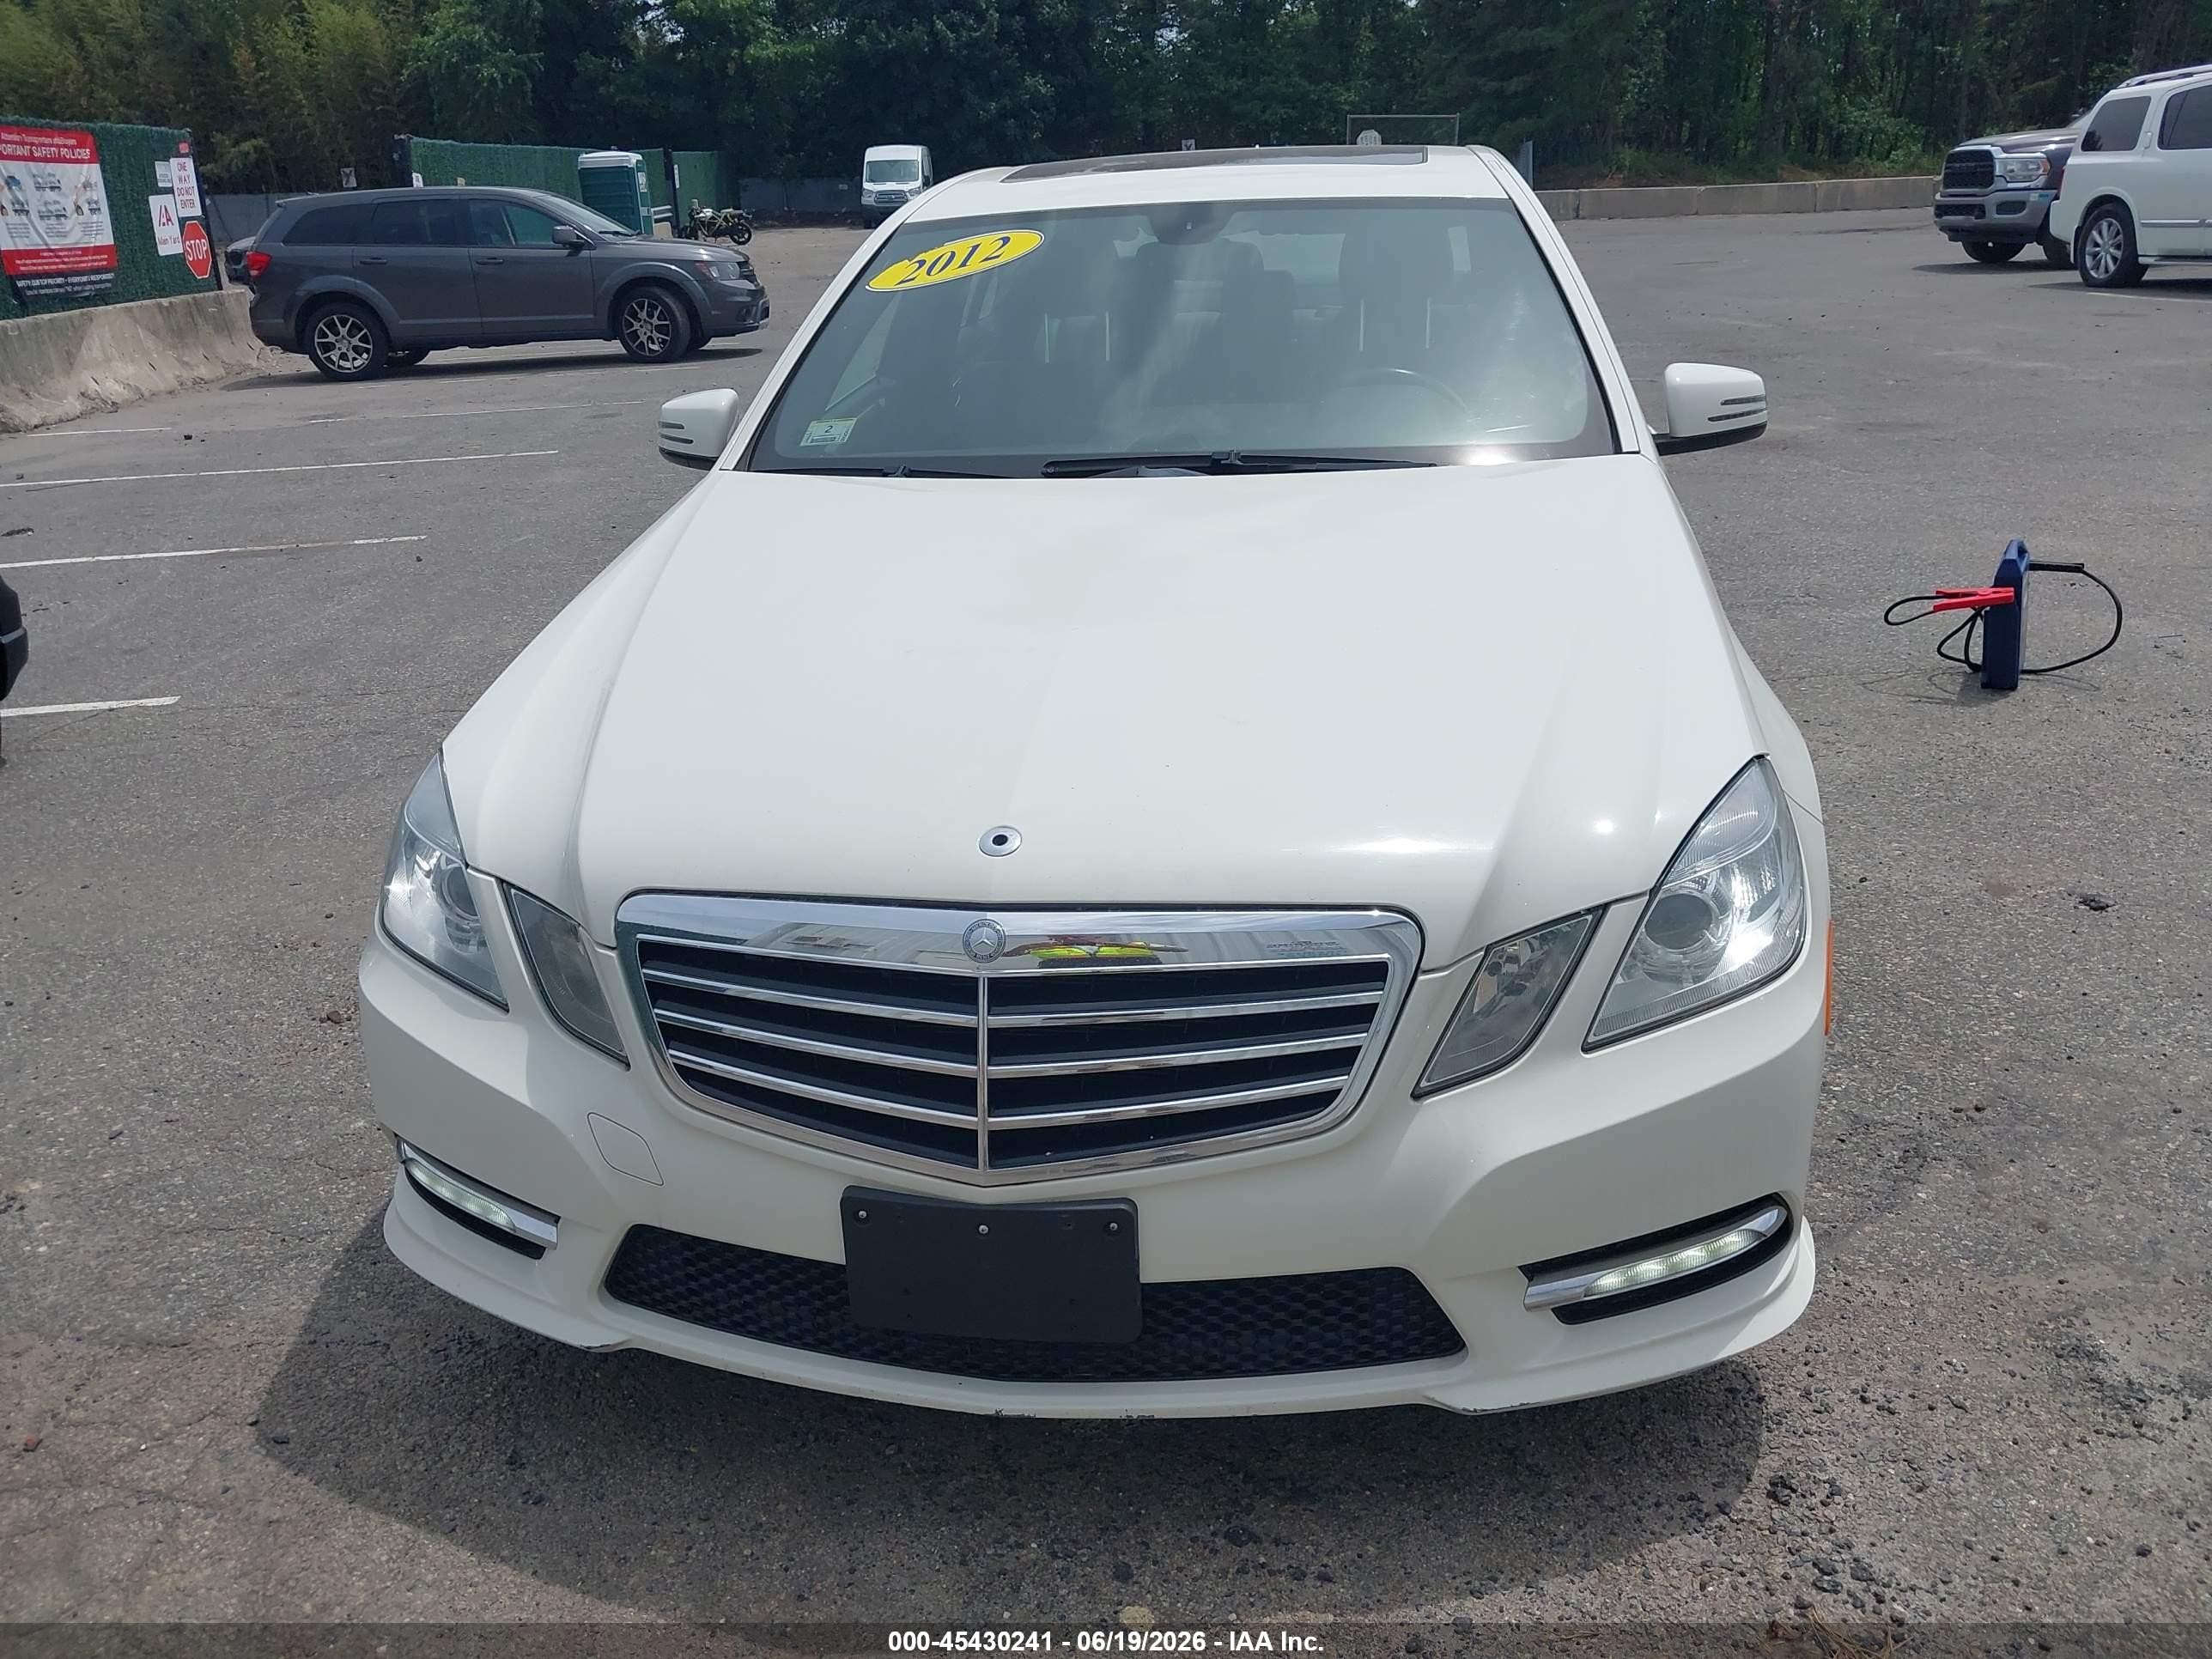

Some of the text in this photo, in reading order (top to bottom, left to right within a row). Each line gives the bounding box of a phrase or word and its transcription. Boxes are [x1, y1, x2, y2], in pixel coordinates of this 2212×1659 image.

[0, 143, 90, 159] ORTANT SAFETY POLICIES
[177, 161, 188, 172] ONE
[178, 174, 191, 184] WAY
[177, 185, 195, 197] DO NOT
[180, 198, 196, 209] ENTER
[185, 239, 208, 261] STOP
[894, 236, 1011, 287] 2012
